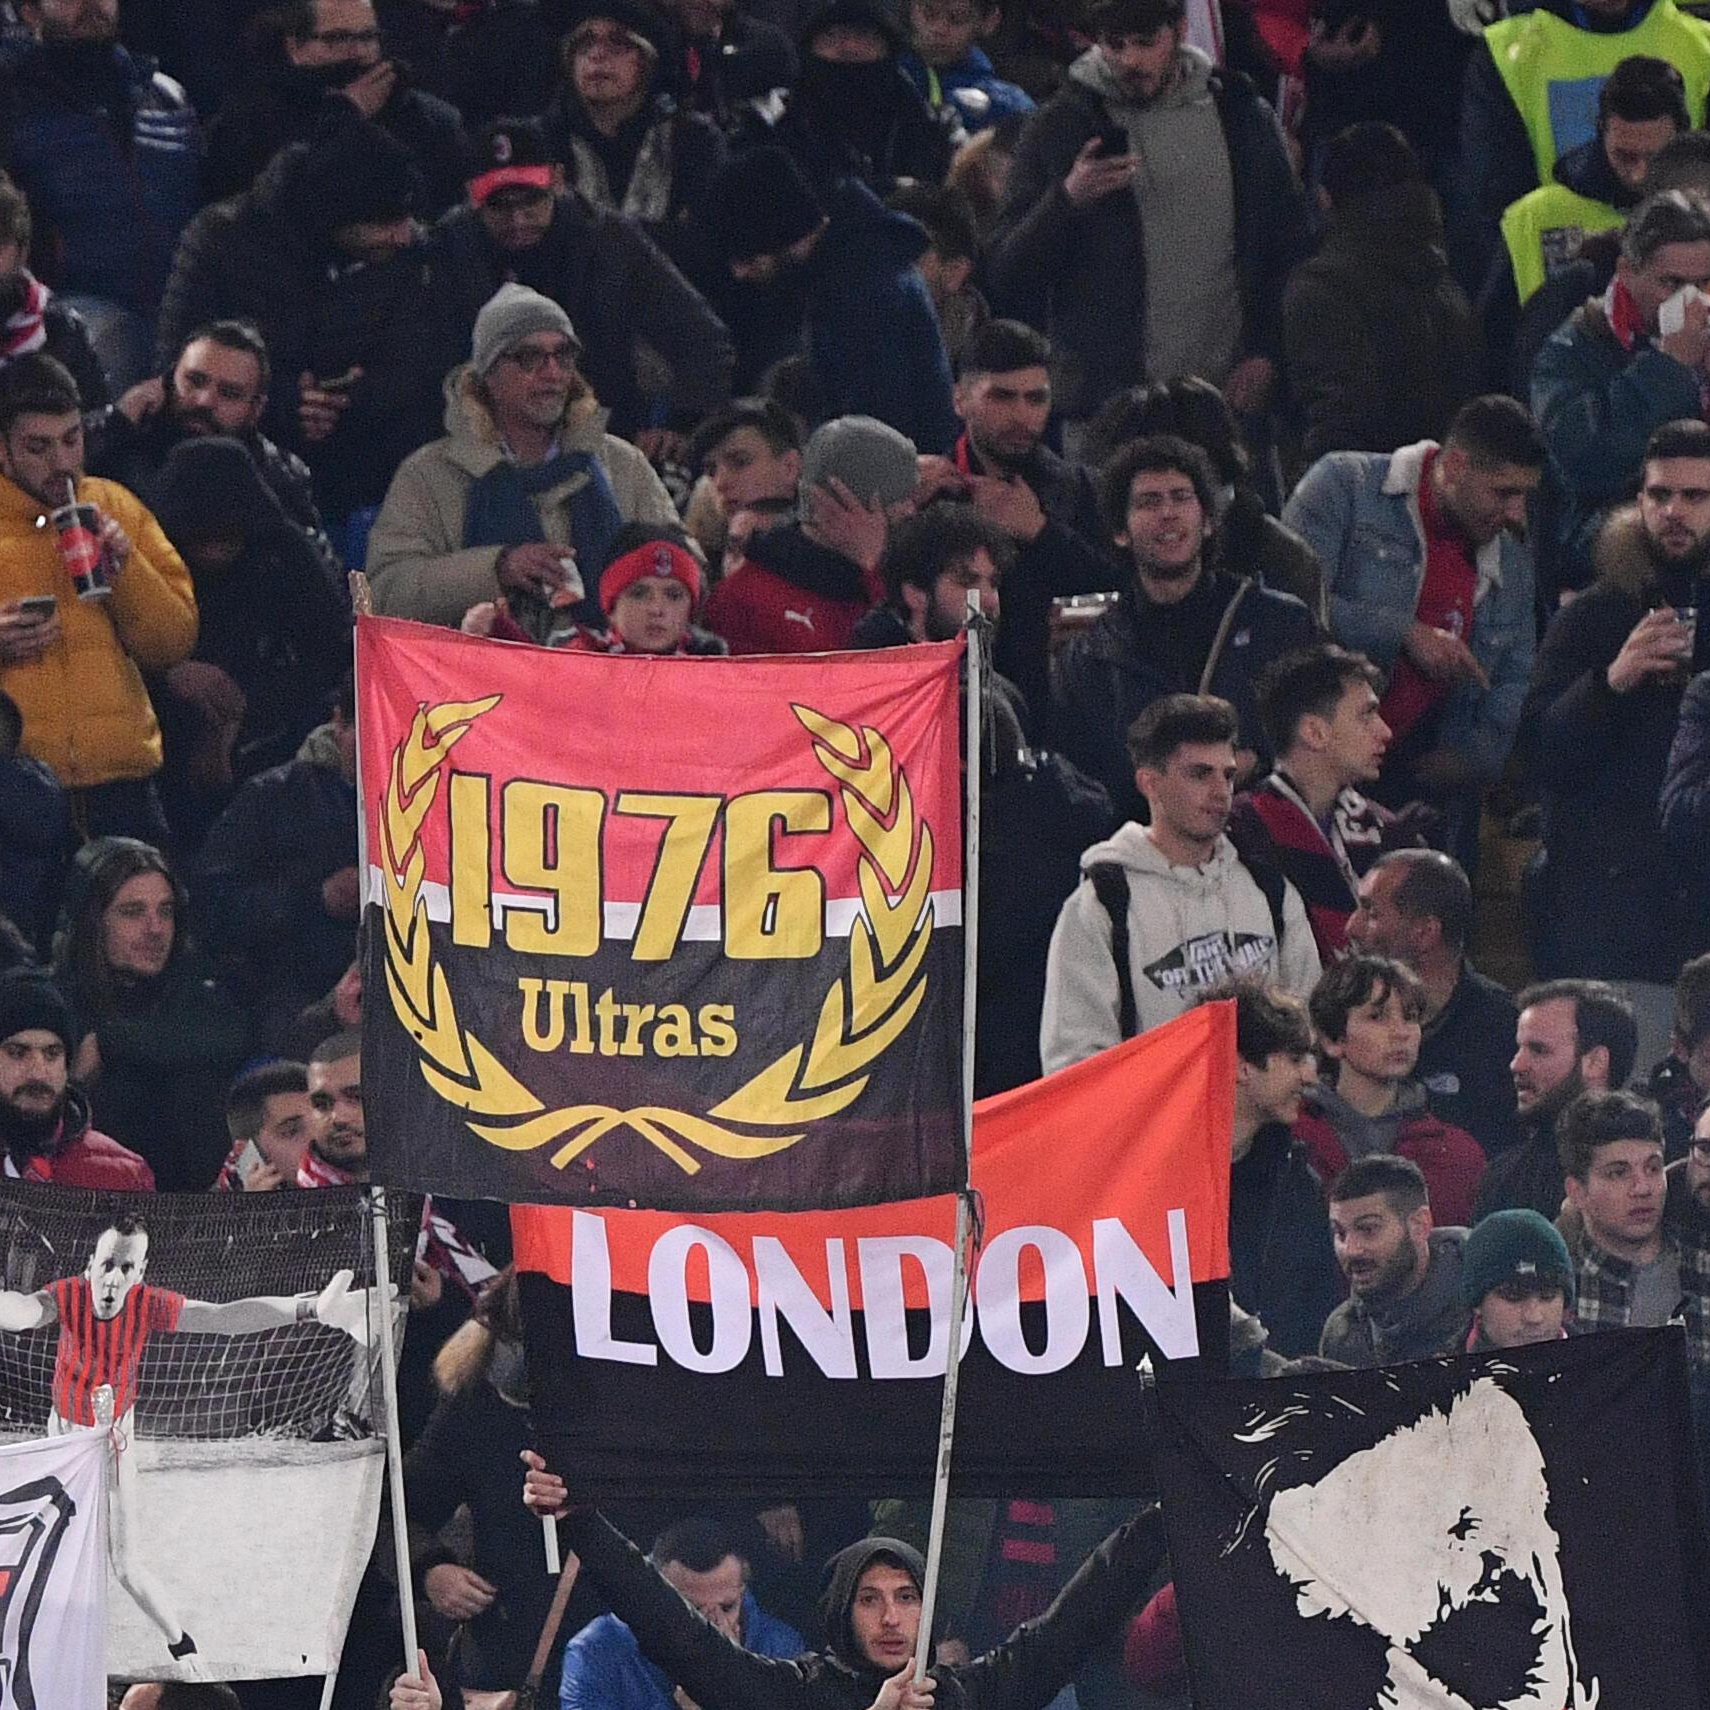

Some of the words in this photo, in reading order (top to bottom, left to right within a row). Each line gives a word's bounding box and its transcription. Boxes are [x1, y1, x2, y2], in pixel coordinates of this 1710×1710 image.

[446, 770, 834, 962] 1976
[517, 978, 739, 1058] Ultras
[572, 1208, 1201, 1381] LONDON
